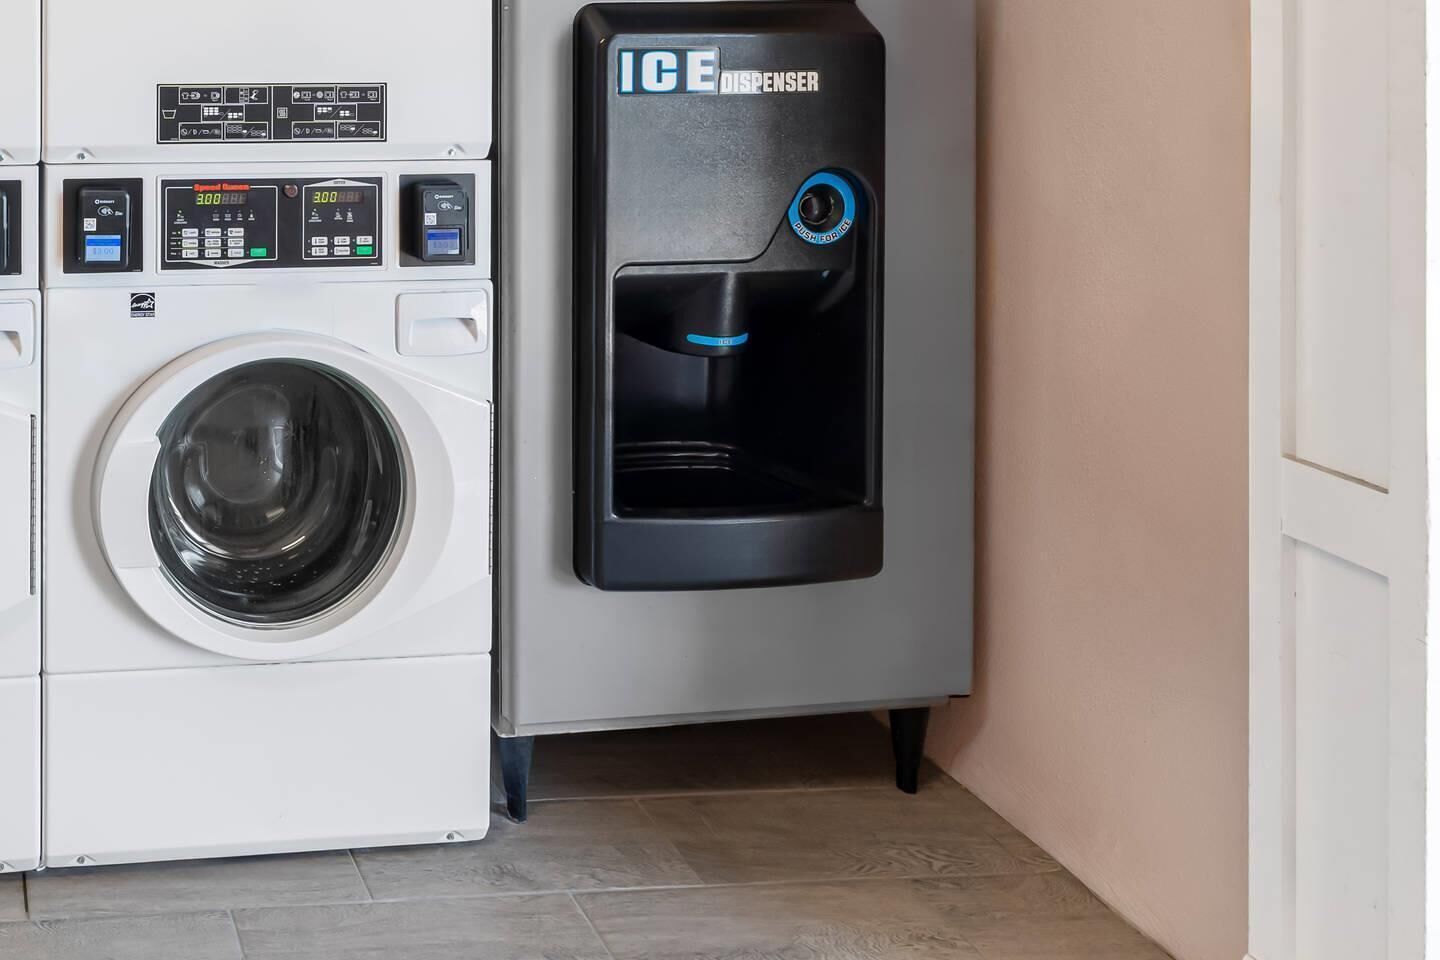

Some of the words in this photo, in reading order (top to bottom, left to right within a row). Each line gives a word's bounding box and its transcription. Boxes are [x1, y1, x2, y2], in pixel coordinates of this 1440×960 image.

[620, 50, 715, 93] ICE
[720, 71, 819, 94] DISPENSER
[193, 184, 221, 192] Speed
[222, 183, 250, 191] Queen
[794, 222, 816, 241] PUSH
[820, 232, 838, 242] FOR
[839, 219, 851, 234] ICE
